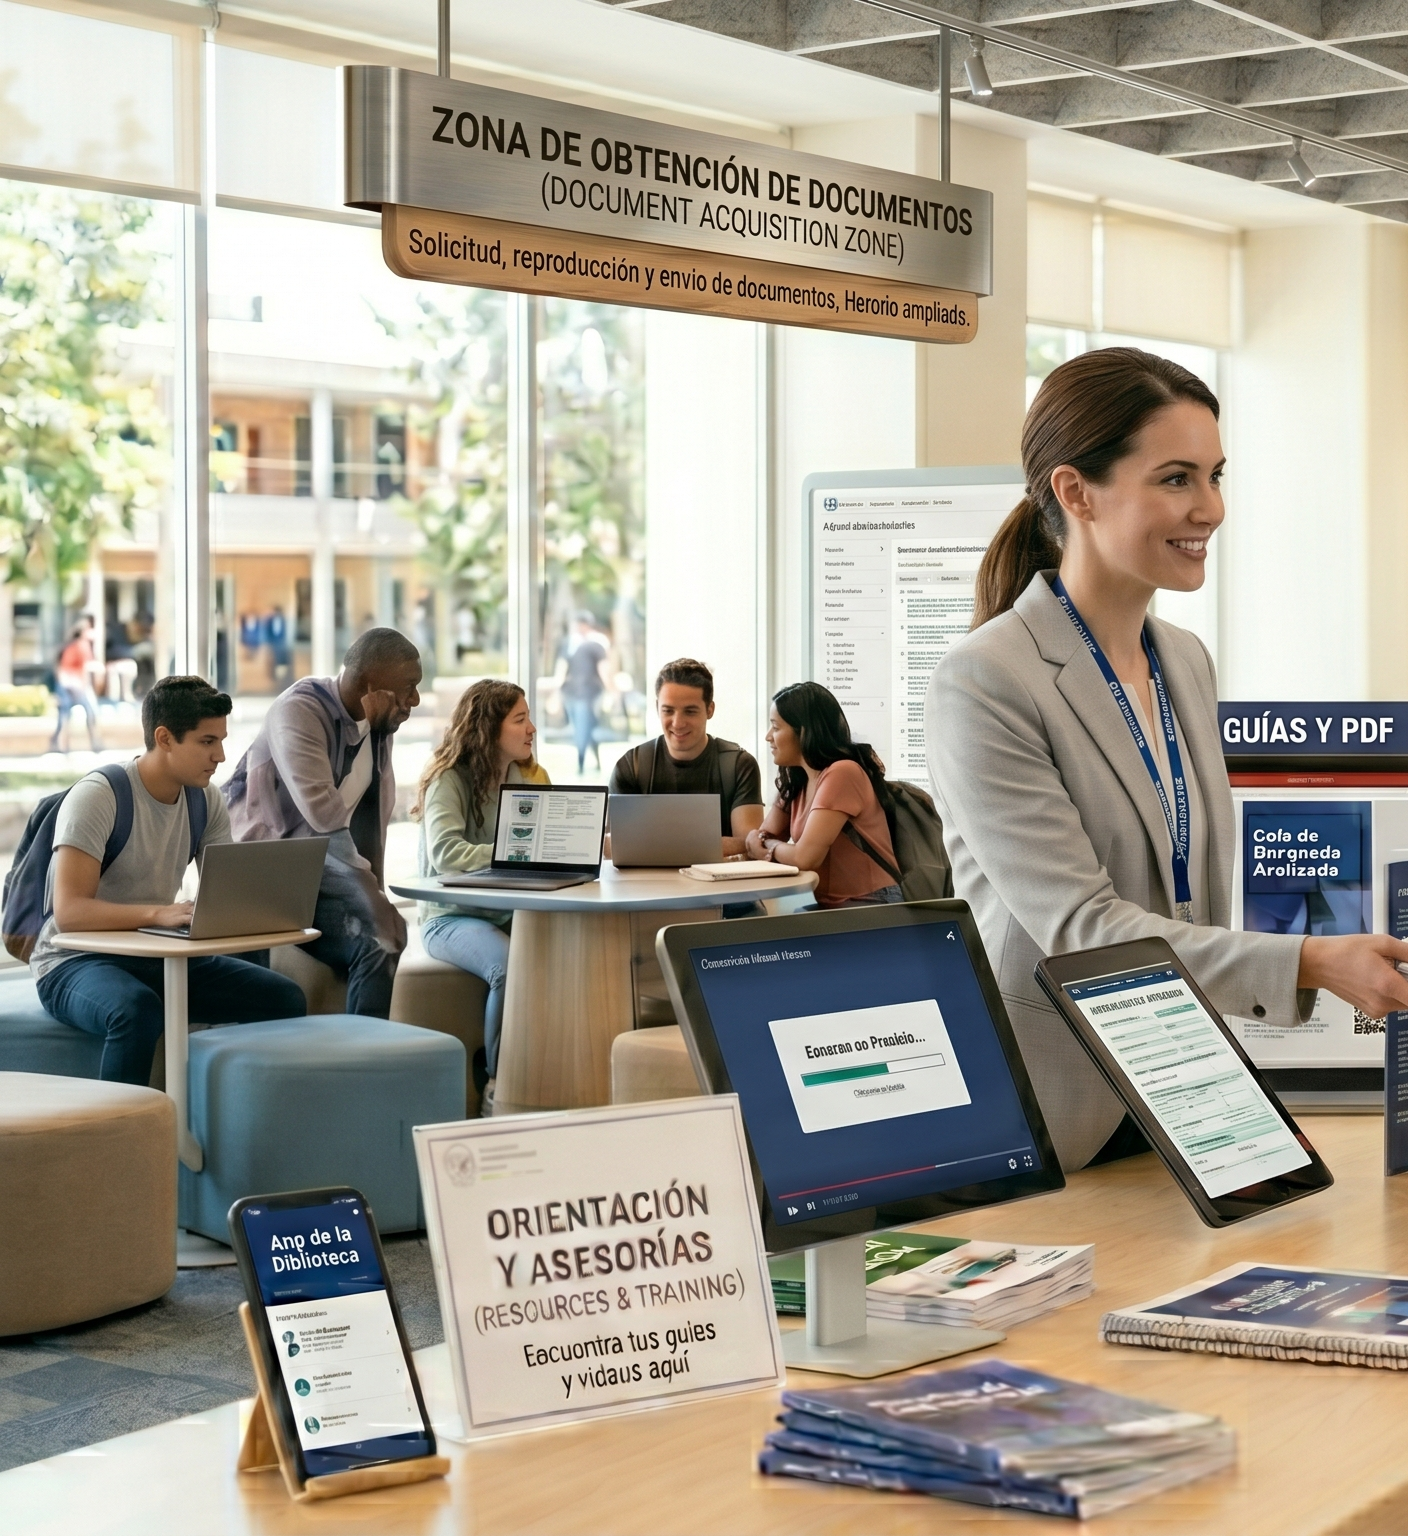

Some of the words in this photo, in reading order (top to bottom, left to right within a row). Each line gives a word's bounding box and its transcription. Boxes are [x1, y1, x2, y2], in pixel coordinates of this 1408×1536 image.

[431, 106, 530, 159] ZONA
[541, 127, 582, 168] DE
[590, 138, 759, 198] OBTENCIÓN
[768, 171, 801, 204] DE
[808, 179, 974, 237] DOCUMENTOS
[541, 171, 693, 225] (DOCUMENT
[699, 201, 838, 249] ACQUISITION
[844, 224, 905, 266] ZONE)
[408, 228, 507, 270] Solicitud,
[513, 248, 640, 284] reproducción
[644, 266, 655, 291] y
[659, 268, 707, 292] envio
[712, 272, 733, 295] de
[737, 275, 840, 313] documentos,
[844, 289, 899, 319] Herorio
[902, 299, 972, 328] ampliads.
[1223, 711, 1307, 743] GUÍAS
[1315, 717, 1333, 743] Y
[1341, 717, 1395, 743] PDF
[1297, 828, 1319, 842] de
[309, 1228, 332, 1246] de
[335, 1226, 353, 1242] la
[487, 1178, 710, 1240] ORIENTACIÓN
[271, 1250, 360, 1273] Diblioteca
[495, 1253, 517, 1288] Y
[530, 1227, 714, 1286] ASESORÍAS
[474, 1289, 610, 1335] (RESOURCES
[616, 1286, 632, 1311] &
[634, 1268, 746, 1308] TRAINING)
[627, 1331, 660, 1352] tus
[665, 1320, 716, 1354] guies
[561, 1374, 573, 1399] y
[648, 1349, 691, 1384] aquí
